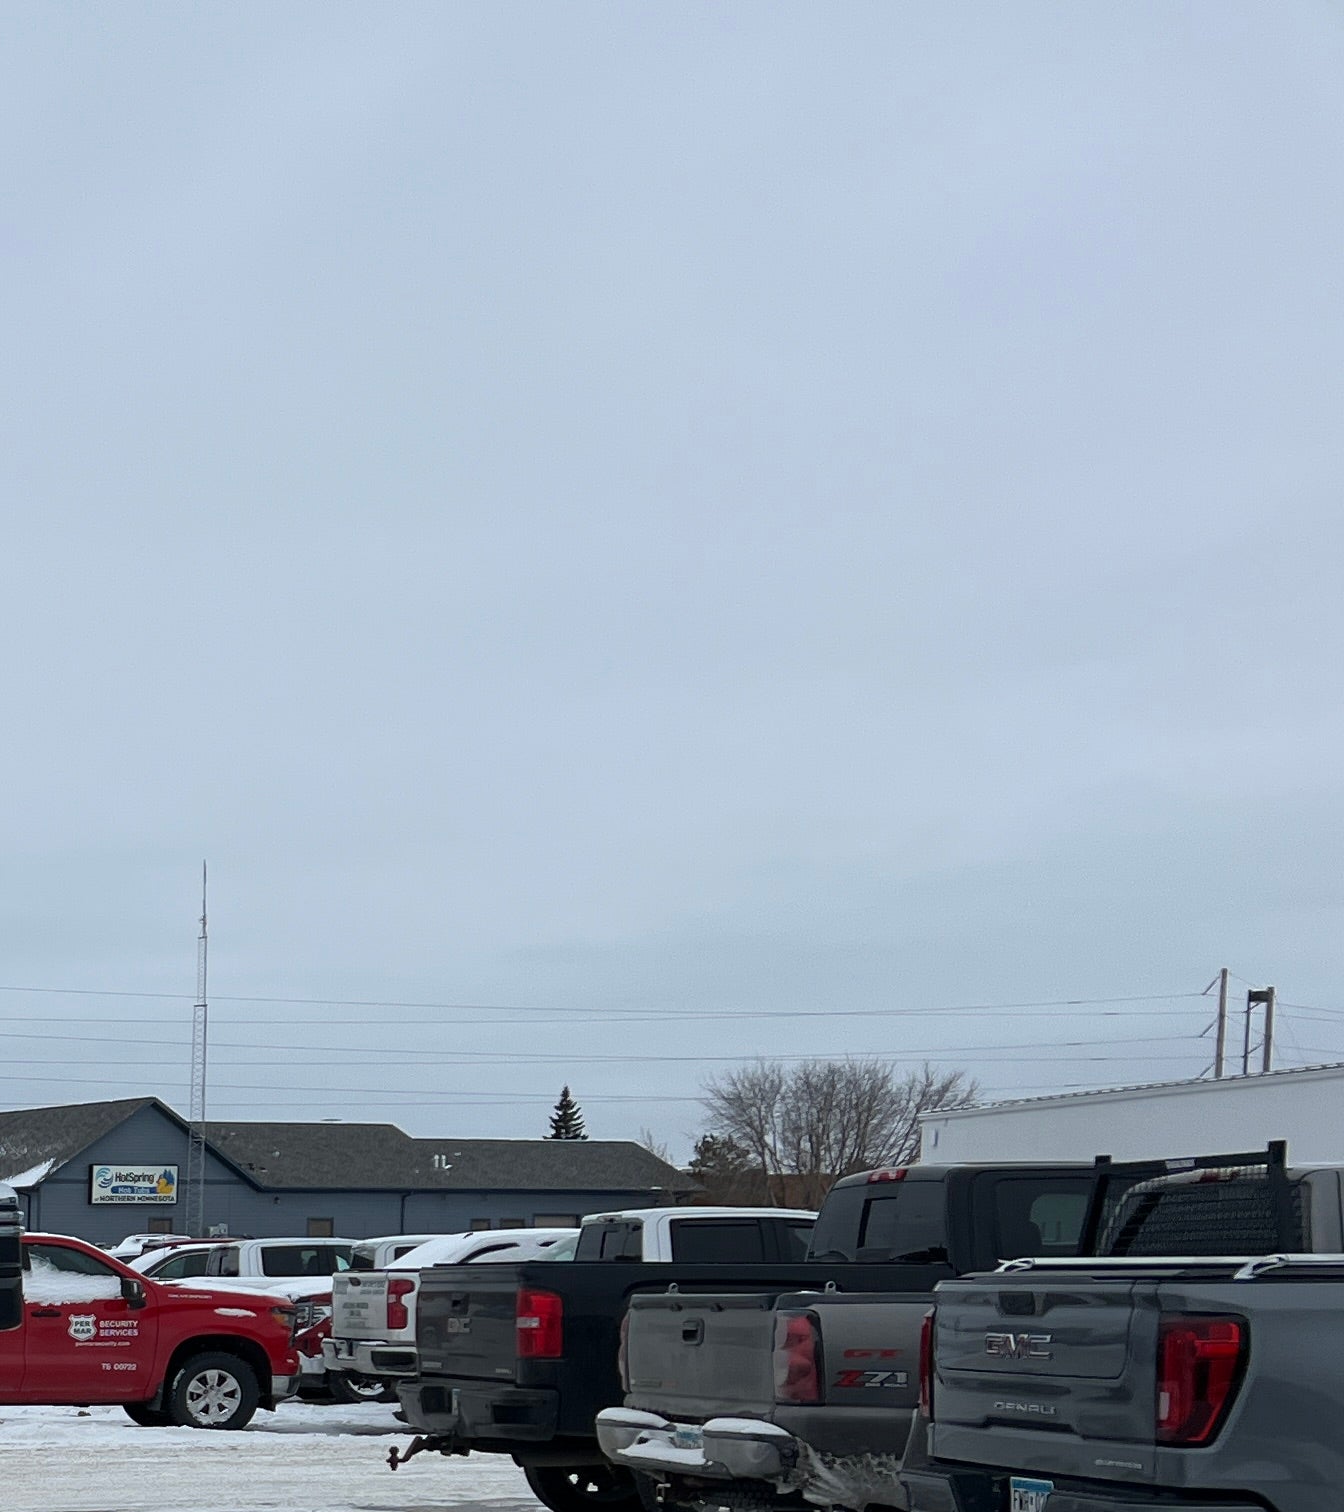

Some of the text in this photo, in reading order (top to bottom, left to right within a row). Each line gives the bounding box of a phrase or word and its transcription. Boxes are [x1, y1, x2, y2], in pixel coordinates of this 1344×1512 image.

[115, 1171, 155, 1184] HotSpring
[99, 1320, 139, 1328] SECURITY
[985, 1333, 1054, 1361] GMC
[836, 1370, 909, 1387] Z71
